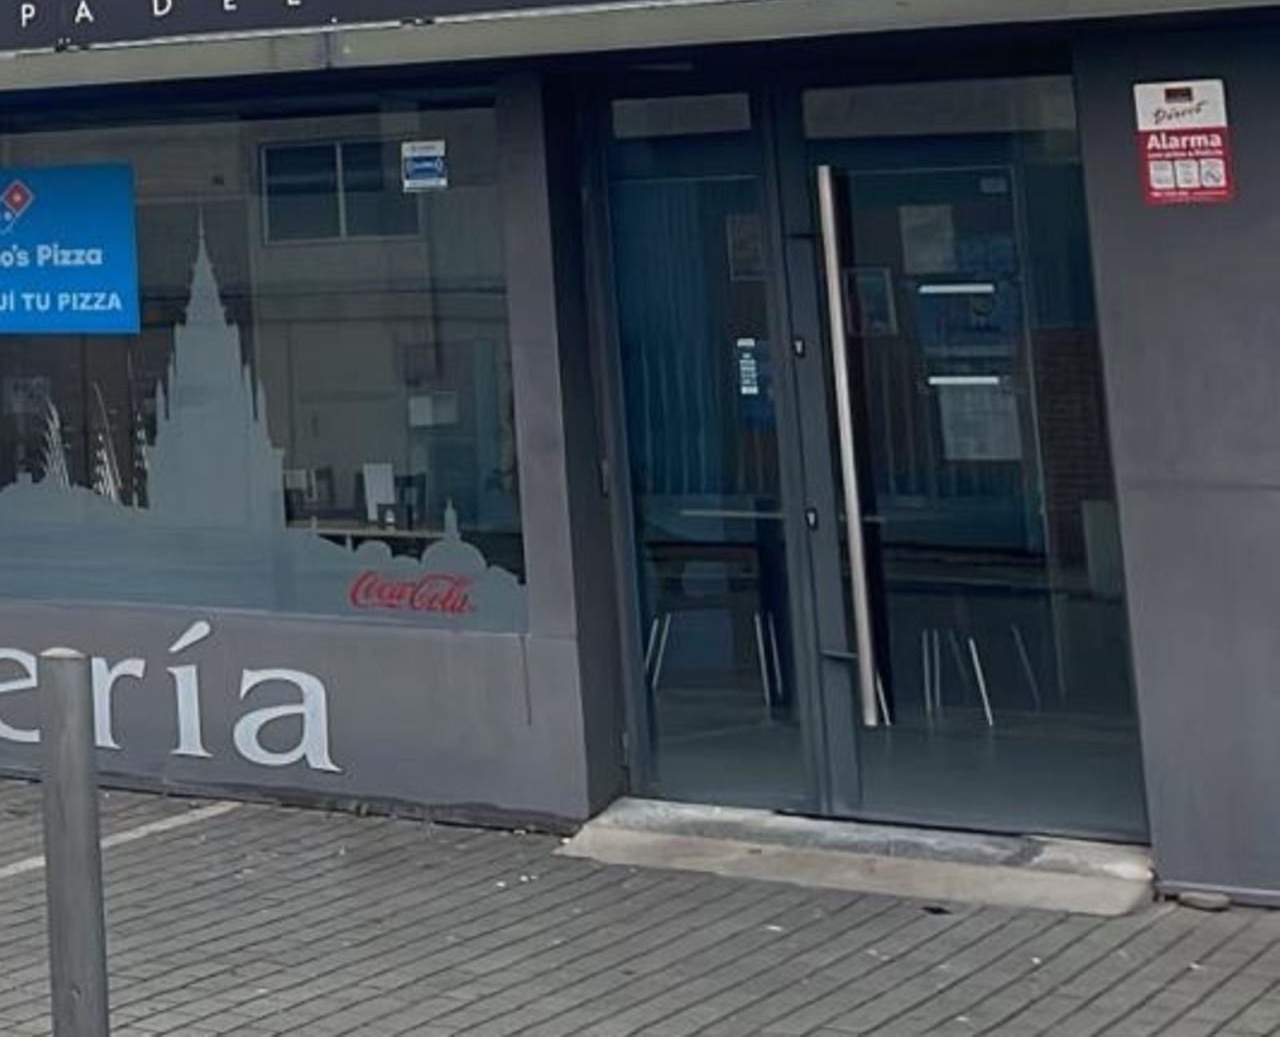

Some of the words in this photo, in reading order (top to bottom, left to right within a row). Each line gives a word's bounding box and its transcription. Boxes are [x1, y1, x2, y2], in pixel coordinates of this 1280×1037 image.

[1146, 132, 1223, 150] Alarma
[36, 243, 104, 267] Pizza
[21, 292, 50, 311] TU
[57, 291, 123, 311] PIZZA
